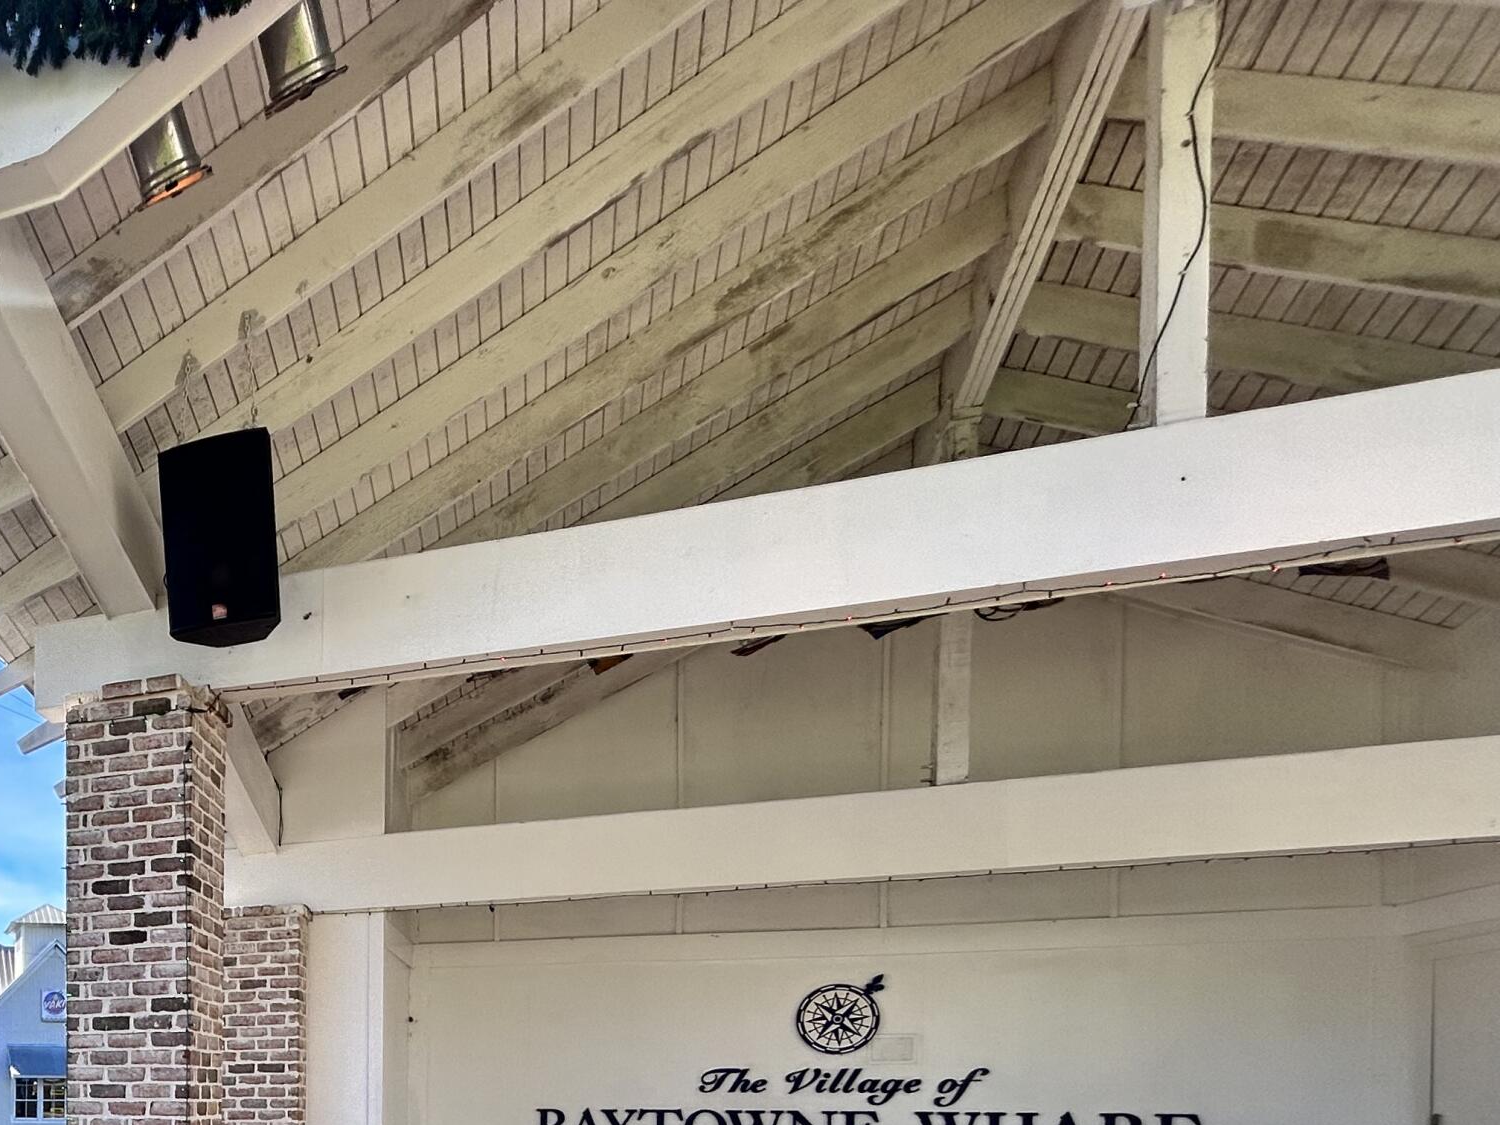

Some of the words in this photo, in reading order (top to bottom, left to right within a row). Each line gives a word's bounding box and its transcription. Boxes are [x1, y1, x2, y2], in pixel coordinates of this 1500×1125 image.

[698, 1067, 768, 1094] The
[785, 1067, 922, 1106] Village
[934, 1067, 991, 1106] of
